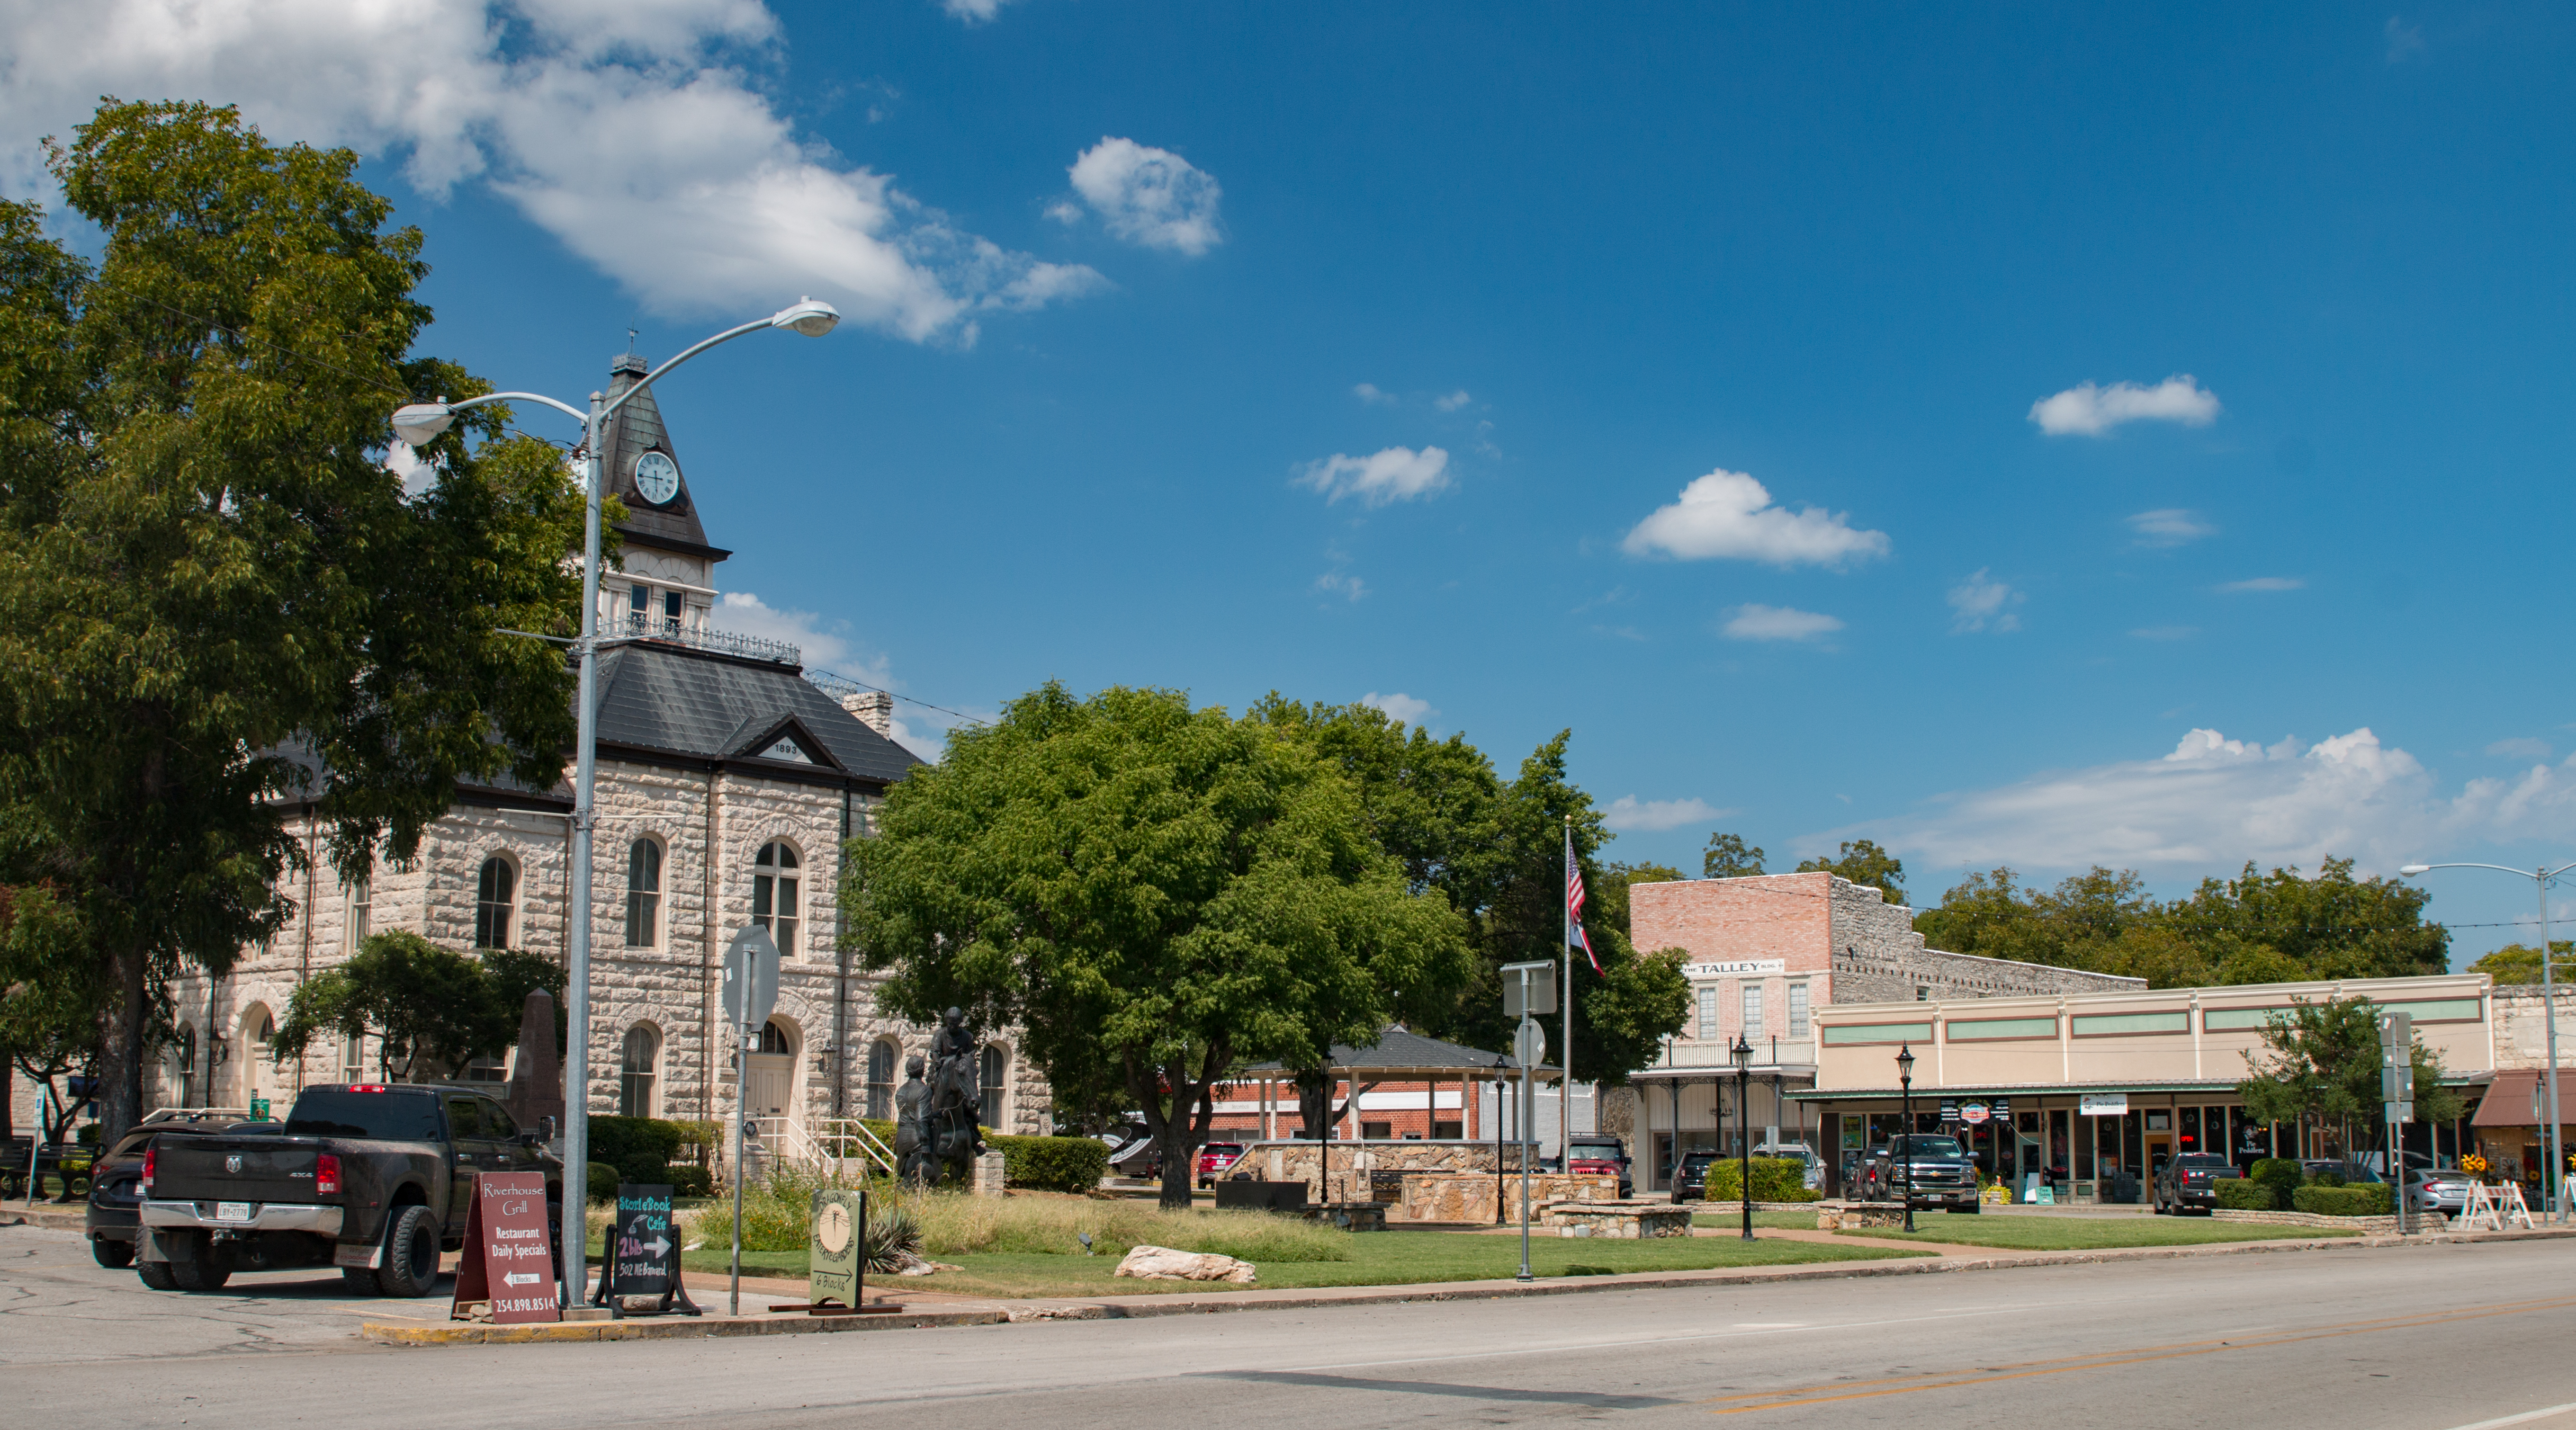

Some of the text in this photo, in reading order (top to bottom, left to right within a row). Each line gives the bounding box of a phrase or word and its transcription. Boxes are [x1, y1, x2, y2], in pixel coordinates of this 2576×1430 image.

[775, 744, 797, 754] 1893
[1698, 963, 1759, 973] TALLEY
[484, 1182, 544, 1198] Riverhouse
[503, 1200, 527, 1216] Grill
[819, 1192, 853, 1212] DRAGONFLY
[647, 1216, 667, 1230] Cafe
[496, 1226, 539, 1239] Restaurant
[492, 1243, 547, 1260] Daily Specials
[619, 1236, 628, 1257] 2
[813, 1233, 829, 1260] EATERY
[832, 1236, 854, 1263] GARDENS
[619, 1263, 634, 1277] 502
[643, 1261, 667, 1276] Barnard
[817, 1274, 845, 1292] 6 Blocks
[495, 1297, 555, 1313] 254.898.8514
